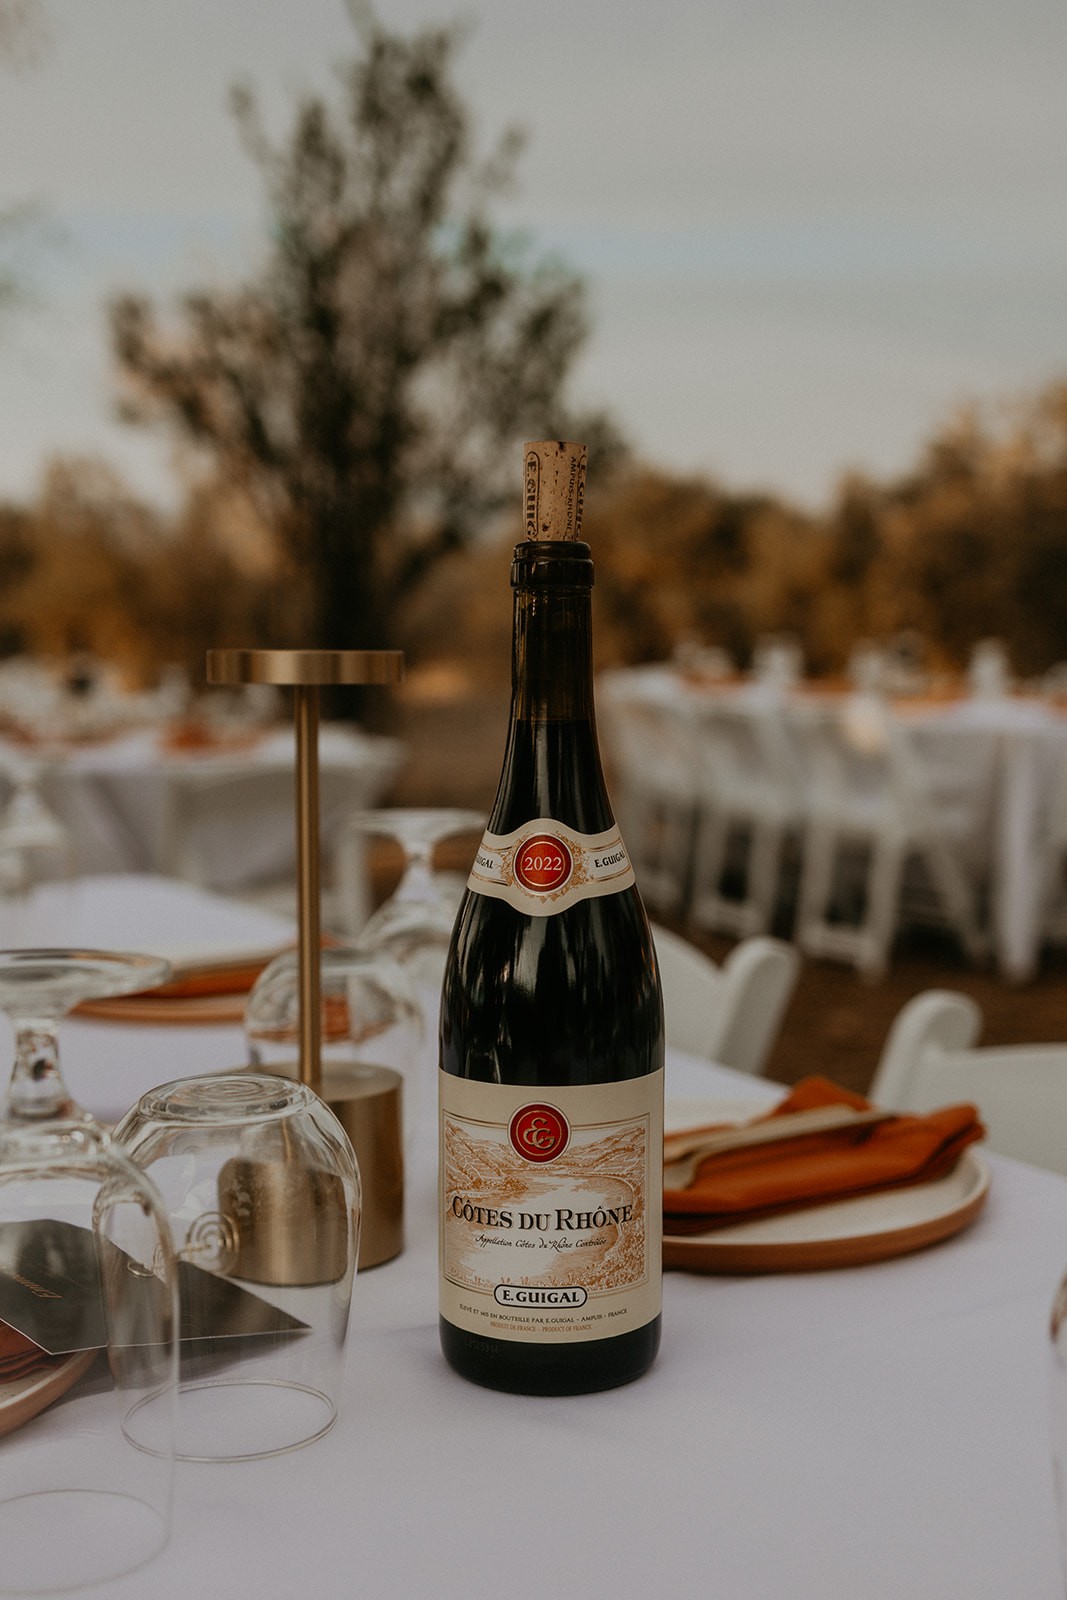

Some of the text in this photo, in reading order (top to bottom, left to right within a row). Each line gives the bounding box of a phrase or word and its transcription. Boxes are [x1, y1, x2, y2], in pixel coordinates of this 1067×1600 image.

[524, 856, 562, 871] 2022
[452, 1195, 633, 1231] CÔTES DU RHÔNE
[475, 1234, 513, 1248] Appellation
[515, 1239, 536, 1249] Côtes
[549, 1236, 573, 1253] Rhône
[502, 1289, 580, 1304] E.GUIGAL
[499, 1314, 530, 1323] BOUTEILLE
[581, 1314, 603, 1322] AMPUIS
[607, 1308, 628, 1317] FRANCE
